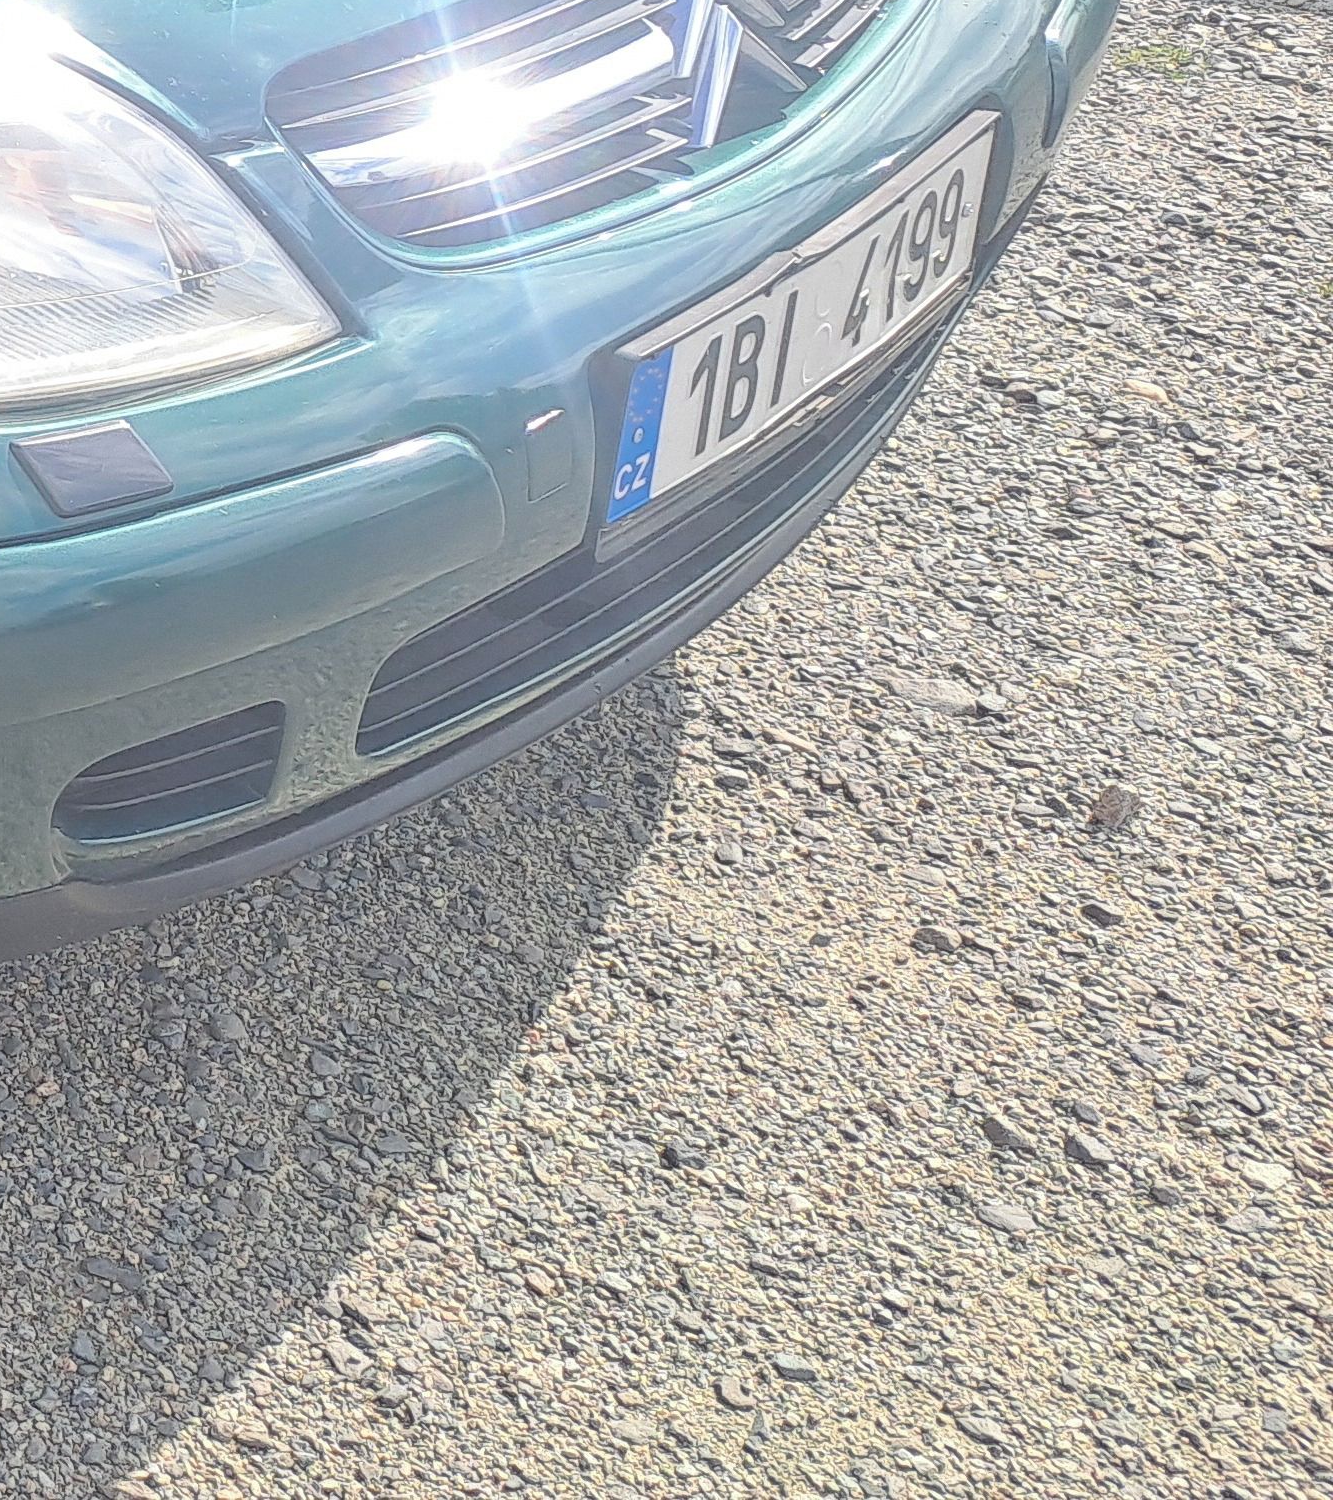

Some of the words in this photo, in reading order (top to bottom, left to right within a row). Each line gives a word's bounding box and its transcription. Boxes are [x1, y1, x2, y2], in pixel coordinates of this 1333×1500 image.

[687, 289, 799, 457] 1BI
[840, 168, 965, 348] 4199
[613, 453, 651, 500] CZ
